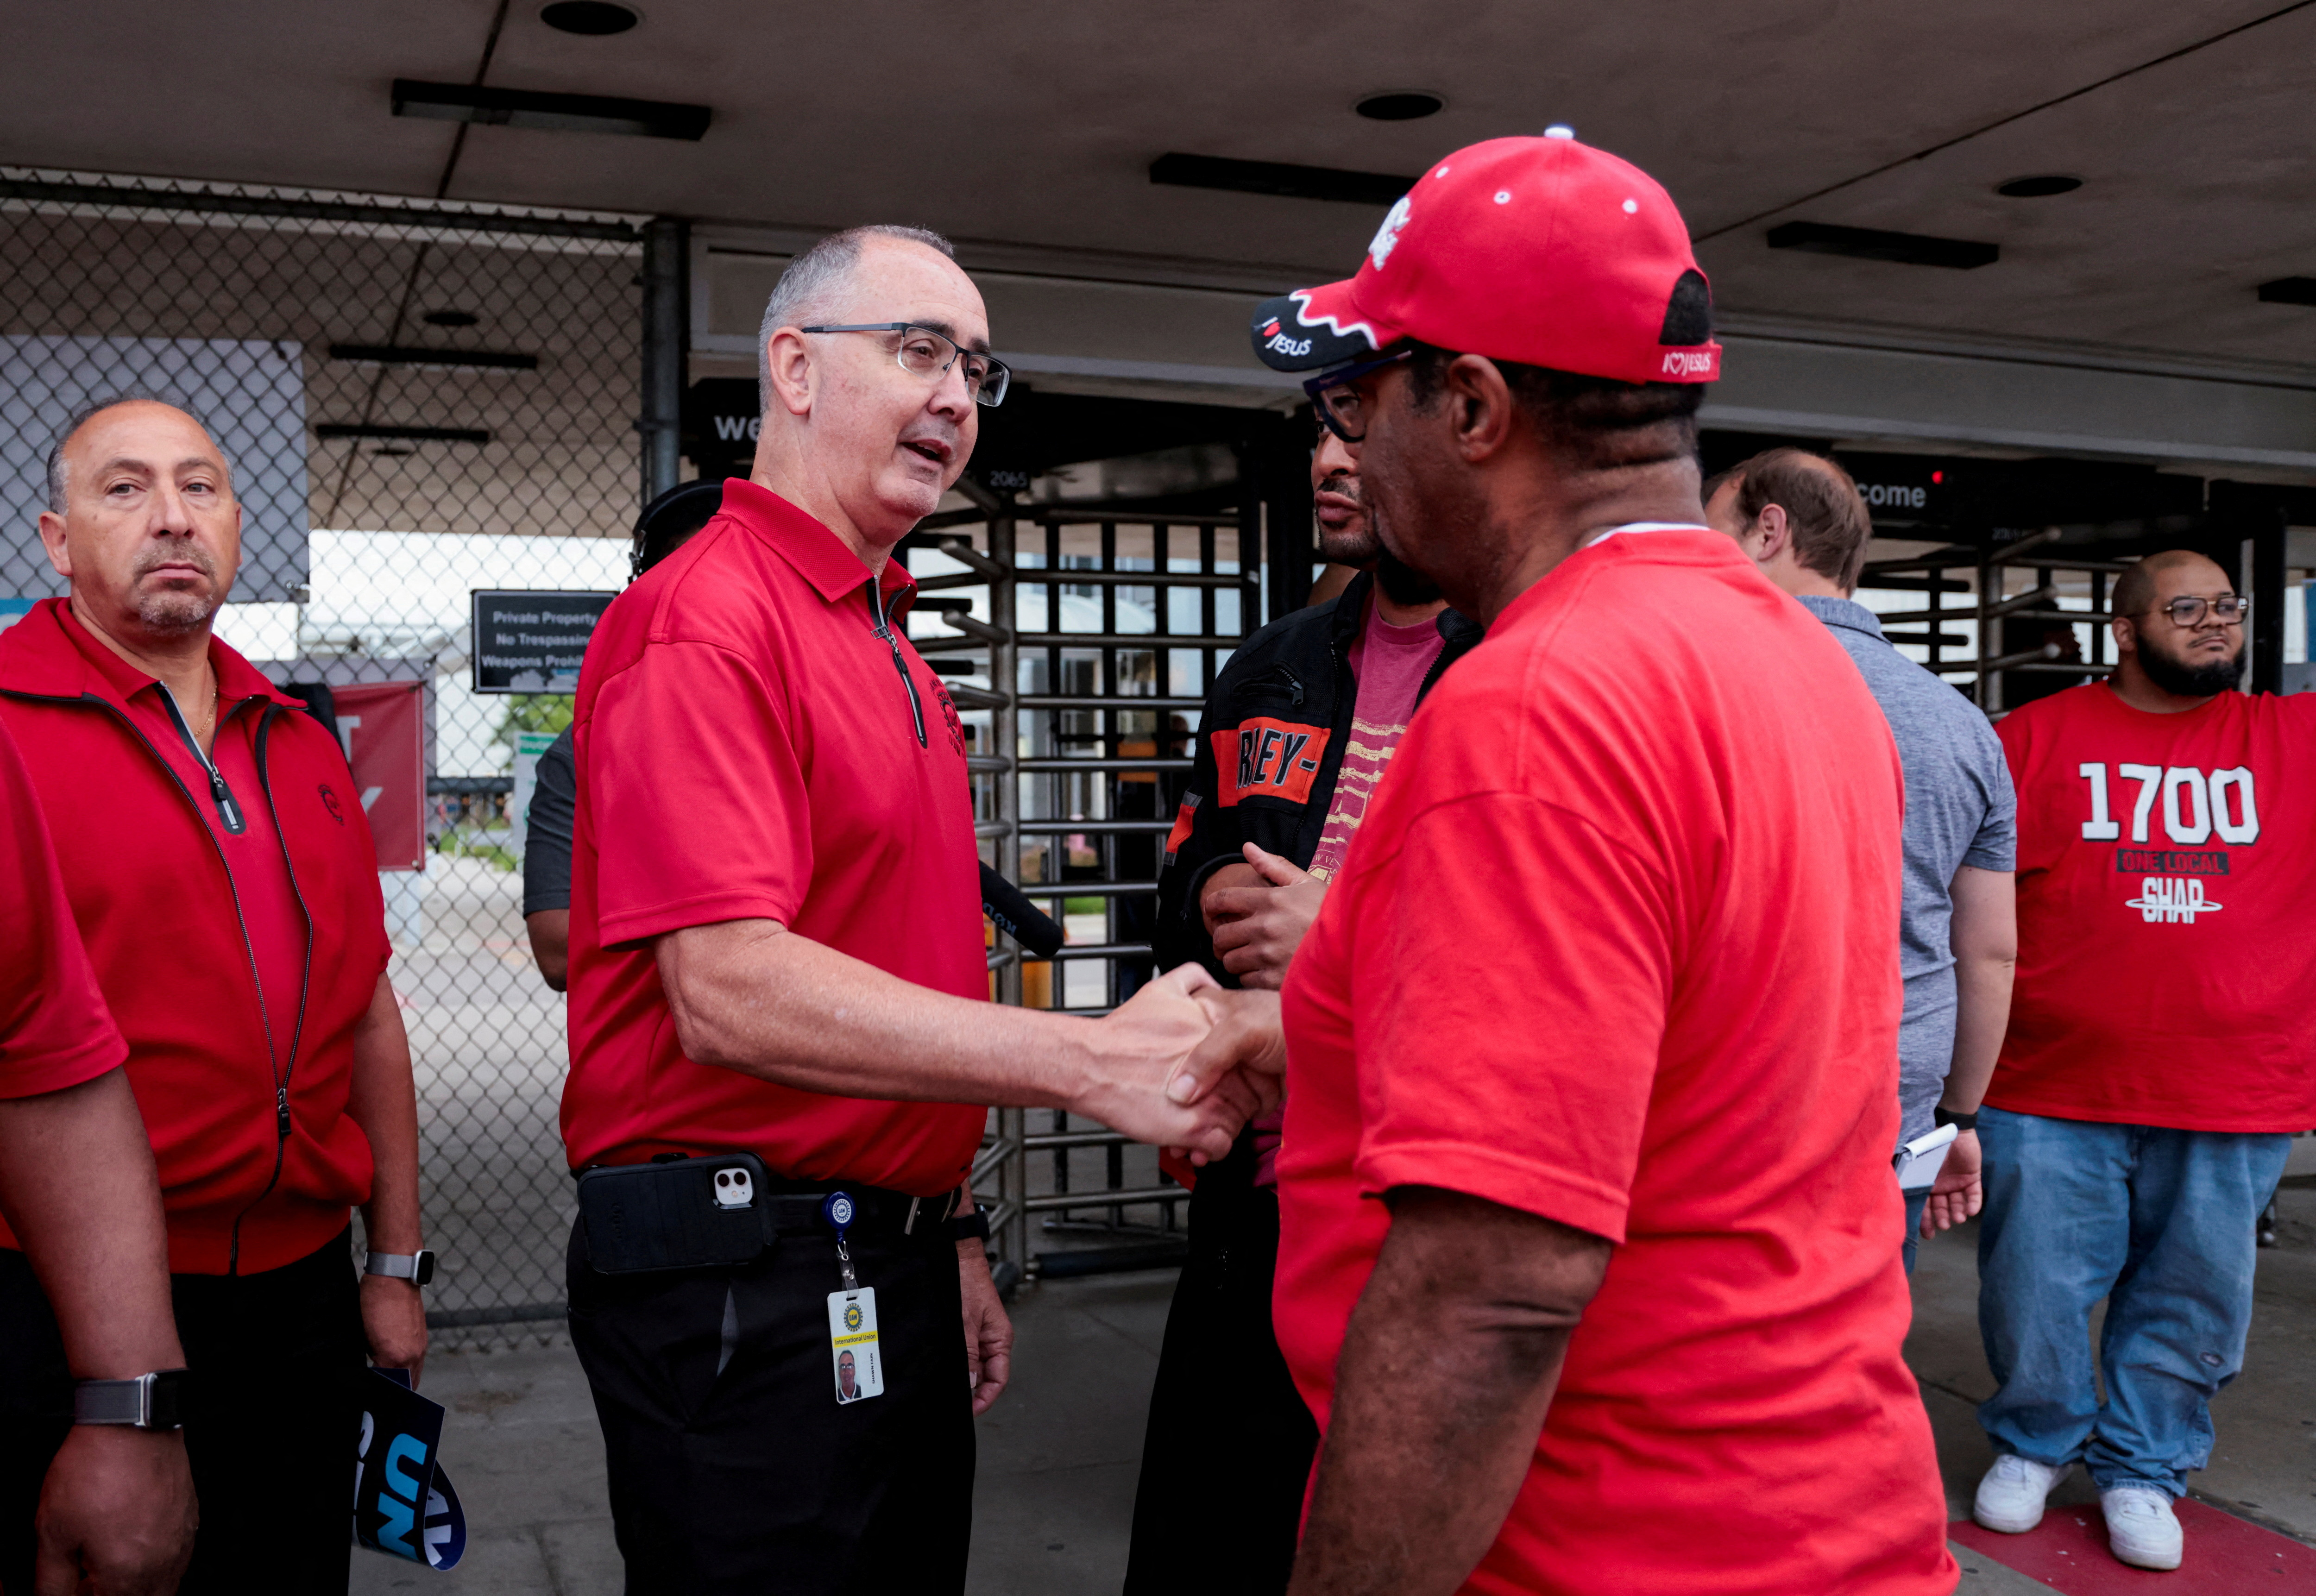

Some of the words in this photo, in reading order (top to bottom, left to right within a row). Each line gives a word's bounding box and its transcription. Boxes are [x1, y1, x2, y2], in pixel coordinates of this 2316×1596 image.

[1265, 333, 1313, 357] JESUS
[1681, 352, 1712, 377] JESUS
[493, 610, 540, 624] Private
[542, 610, 598, 628] Property
[496, 633, 516, 646] No
[481, 654, 543, 670] Weapons
[2079, 762, 2261, 847] 1700
[2122, 852, 2160, 872] ONE
[2164, 853, 2224, 873] LOCAL
[2141, 877, 2204, 924] SHAP
[835, 1335, 862, 1345] International
